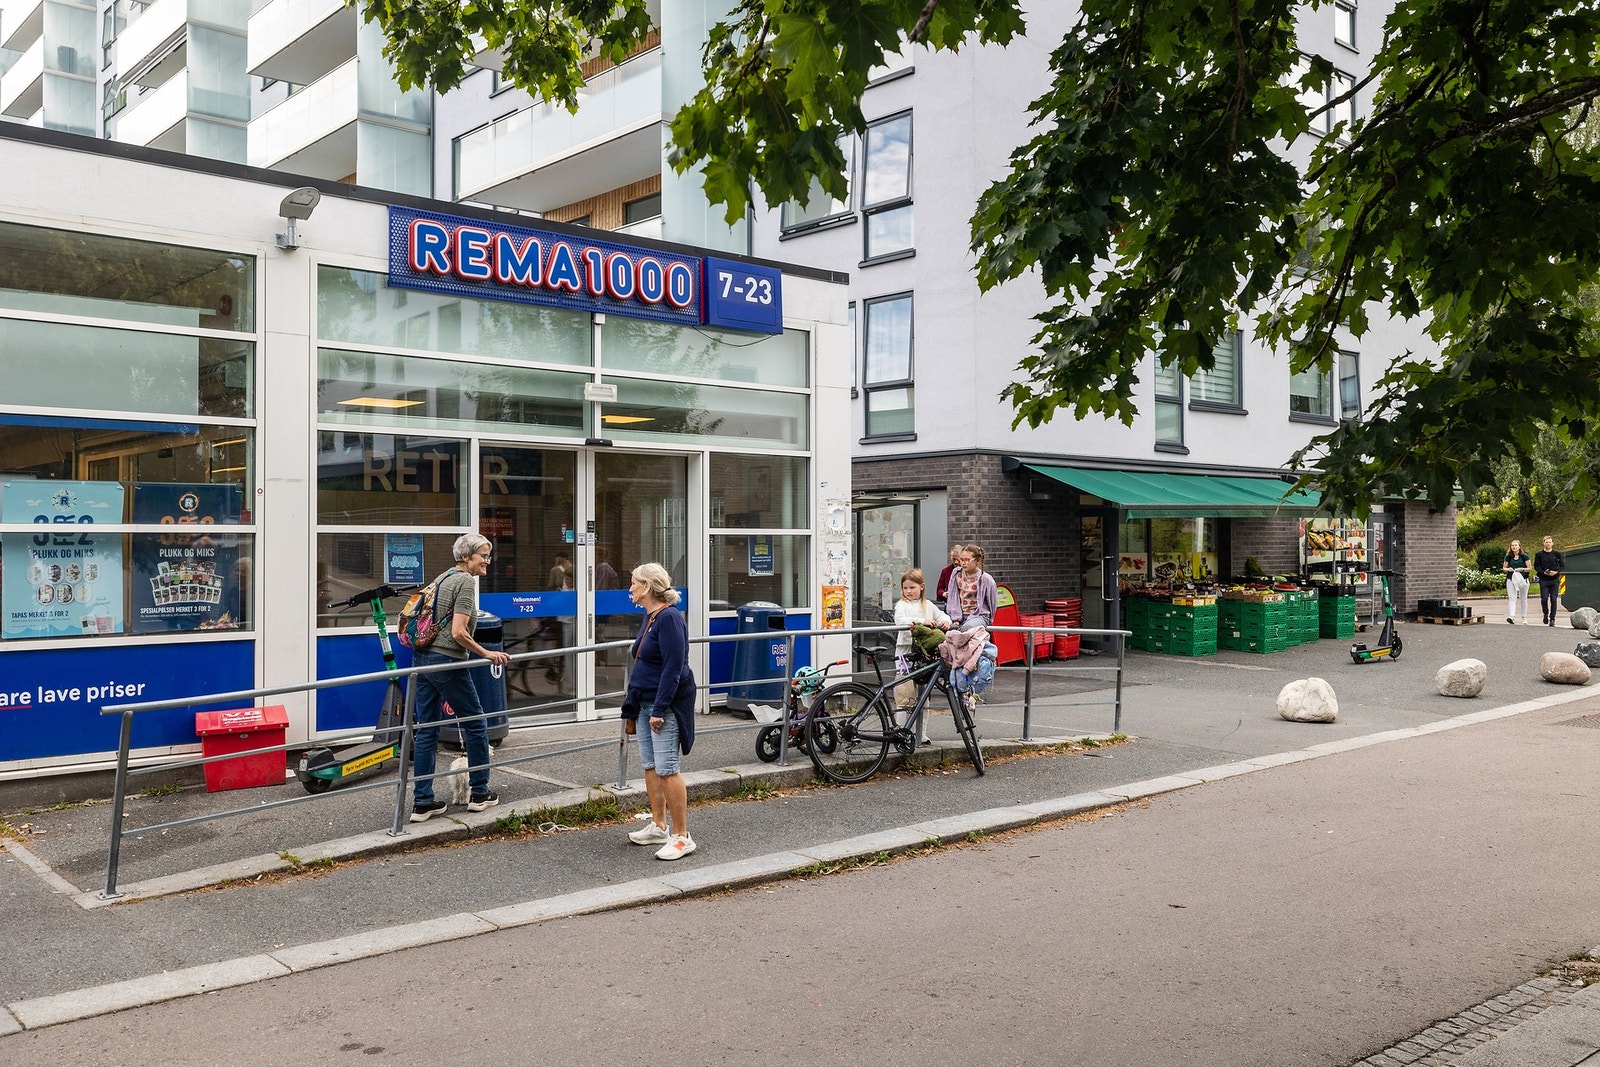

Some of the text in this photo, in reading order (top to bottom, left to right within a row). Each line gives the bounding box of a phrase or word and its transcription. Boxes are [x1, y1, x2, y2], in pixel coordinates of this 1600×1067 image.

[718, 271, 773, 306] 7-23
[363, 450, 509, 495] RETR
[32, 548, 94, 559] PLUKK OG MIKS
[159, 548, 215, 558] PLUKK OG MIKS
[520, 605, 534, 613] 7-23
[11, 611, 27, 619] TAPAS
[38, 686, 81, 703] lave
[87, 681, 146, 703] priser
